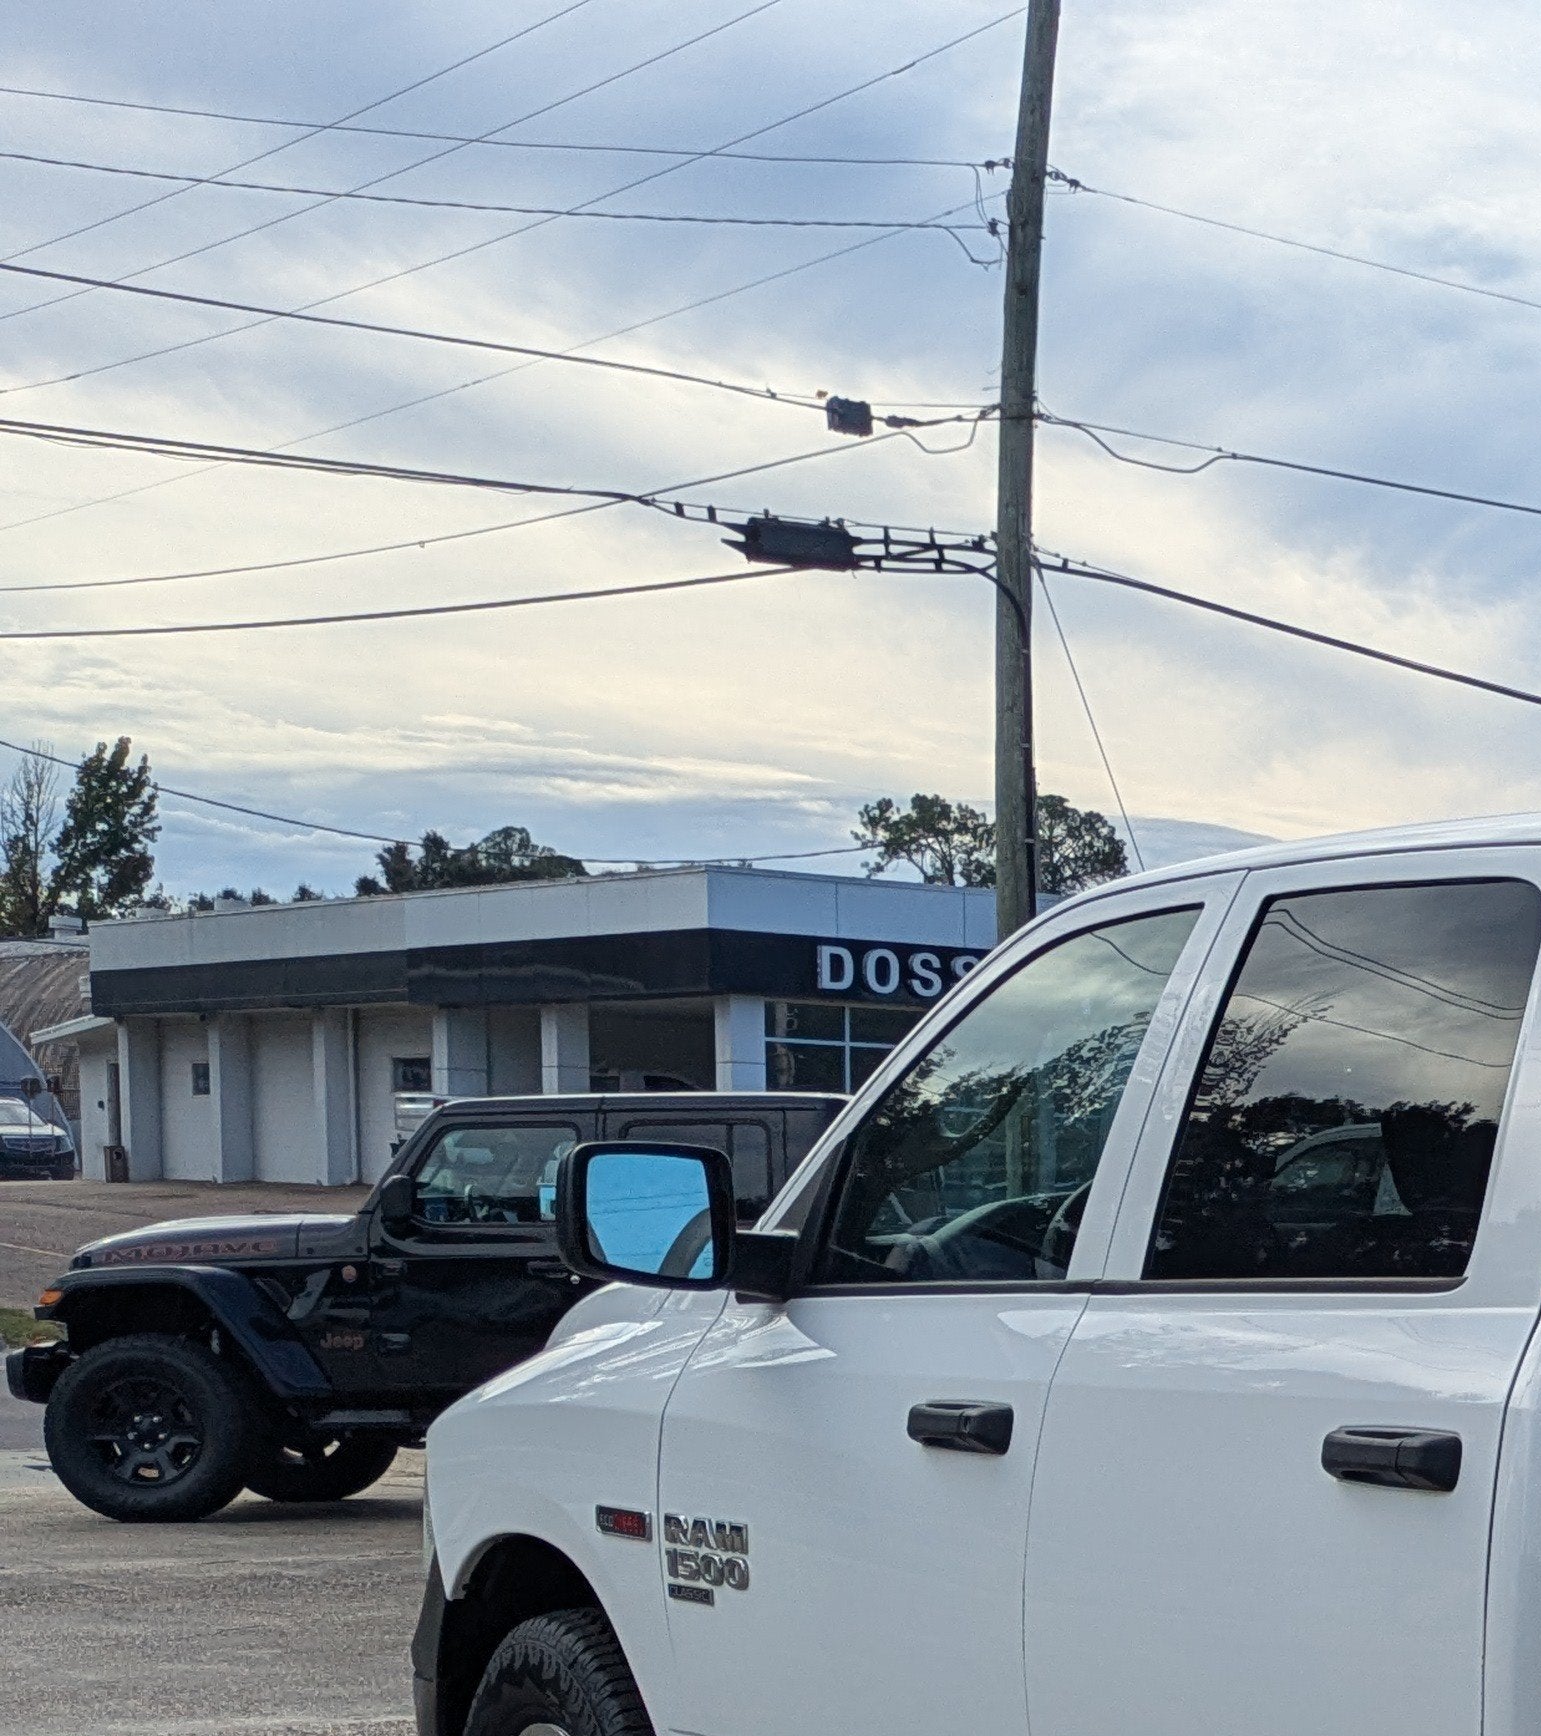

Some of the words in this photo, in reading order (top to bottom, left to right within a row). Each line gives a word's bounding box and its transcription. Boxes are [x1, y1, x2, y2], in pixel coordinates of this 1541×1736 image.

[320, 1332, 366, 1351] Jeep
[664, 1512, 749, 1556] RAM
[664, 1547, 750, 1591] 1500
